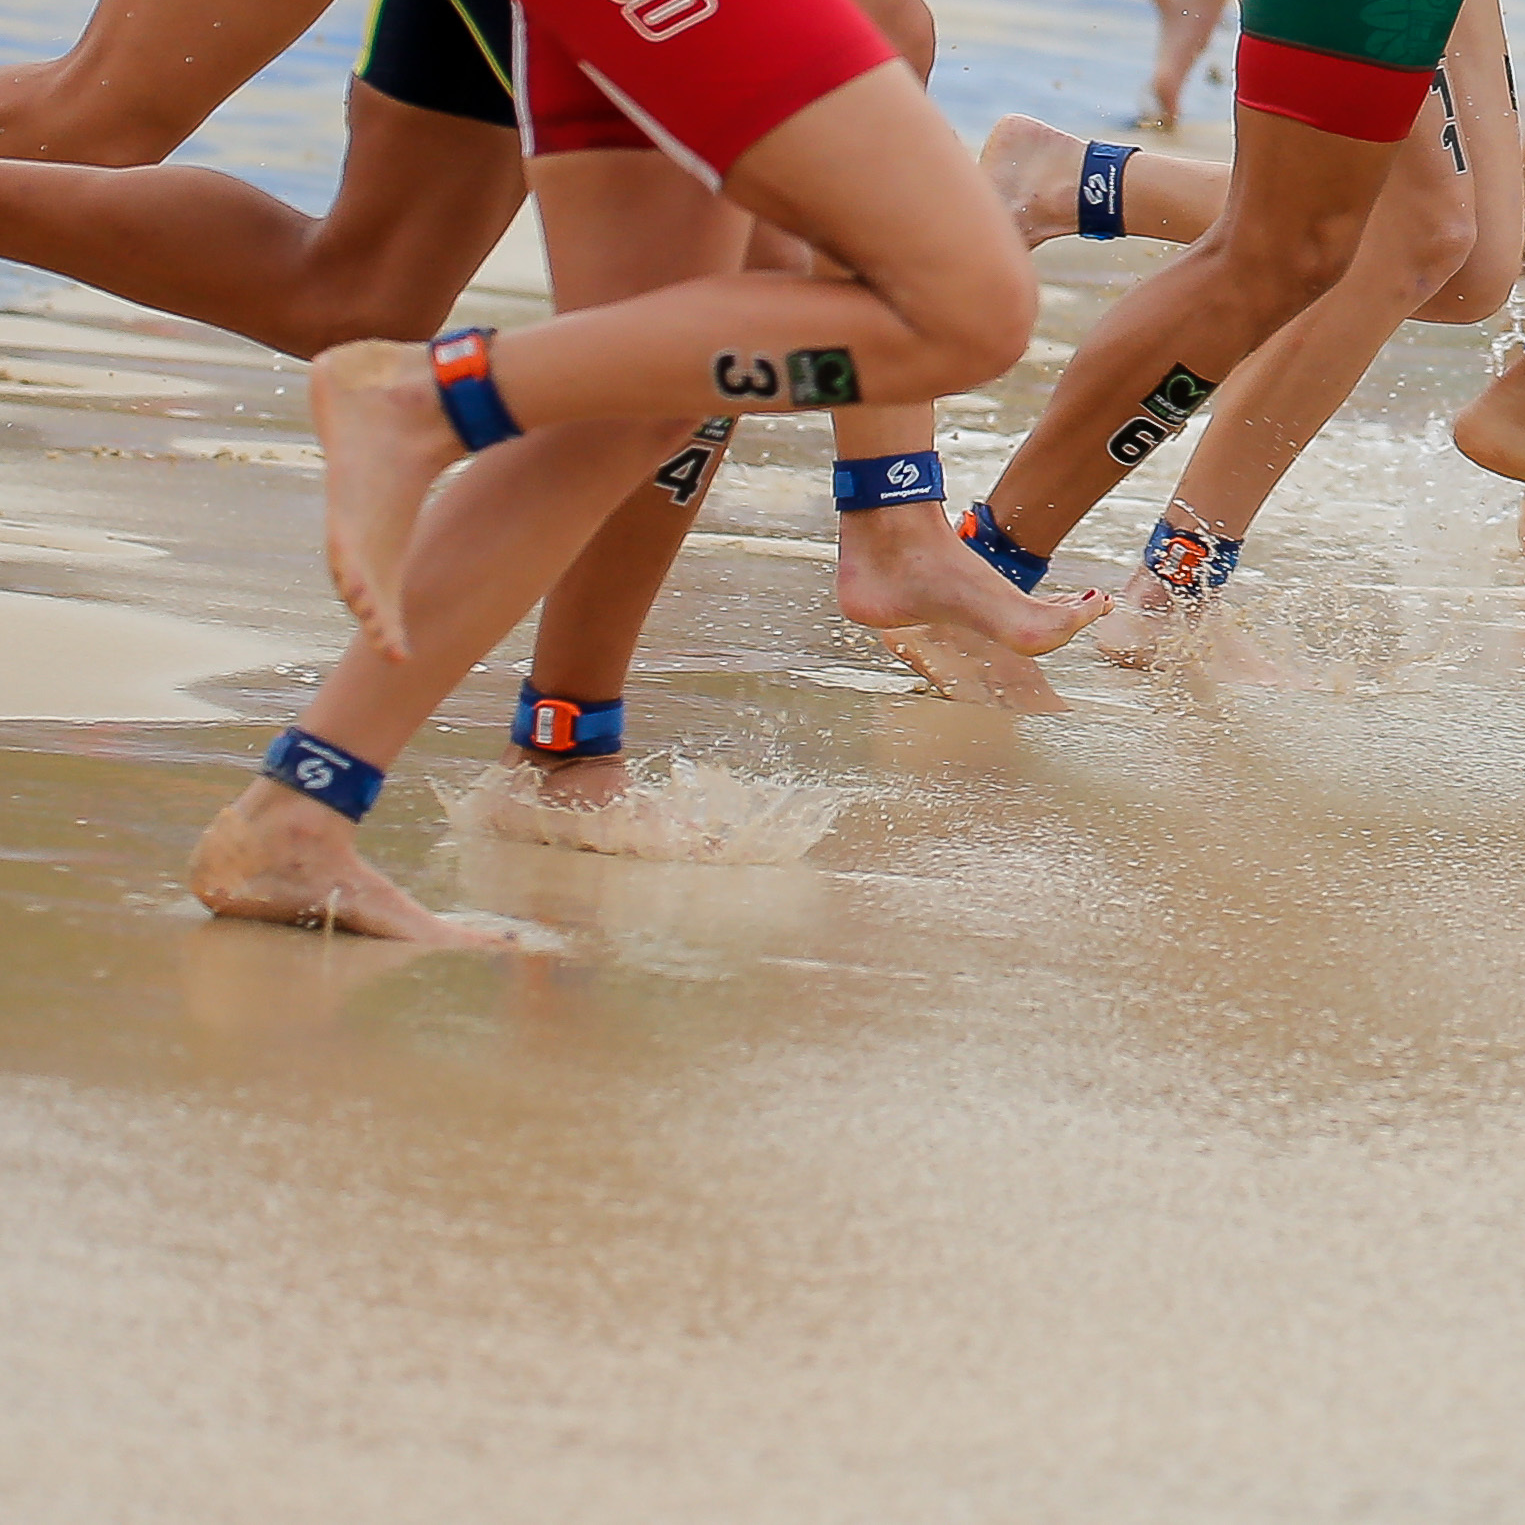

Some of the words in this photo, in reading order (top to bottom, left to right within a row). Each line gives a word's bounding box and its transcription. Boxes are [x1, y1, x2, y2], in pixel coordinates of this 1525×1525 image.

[711, 348, 781, 402] 3
[1106, 415, 1169, 467] 6
[653, 443, 715, 507] 4
